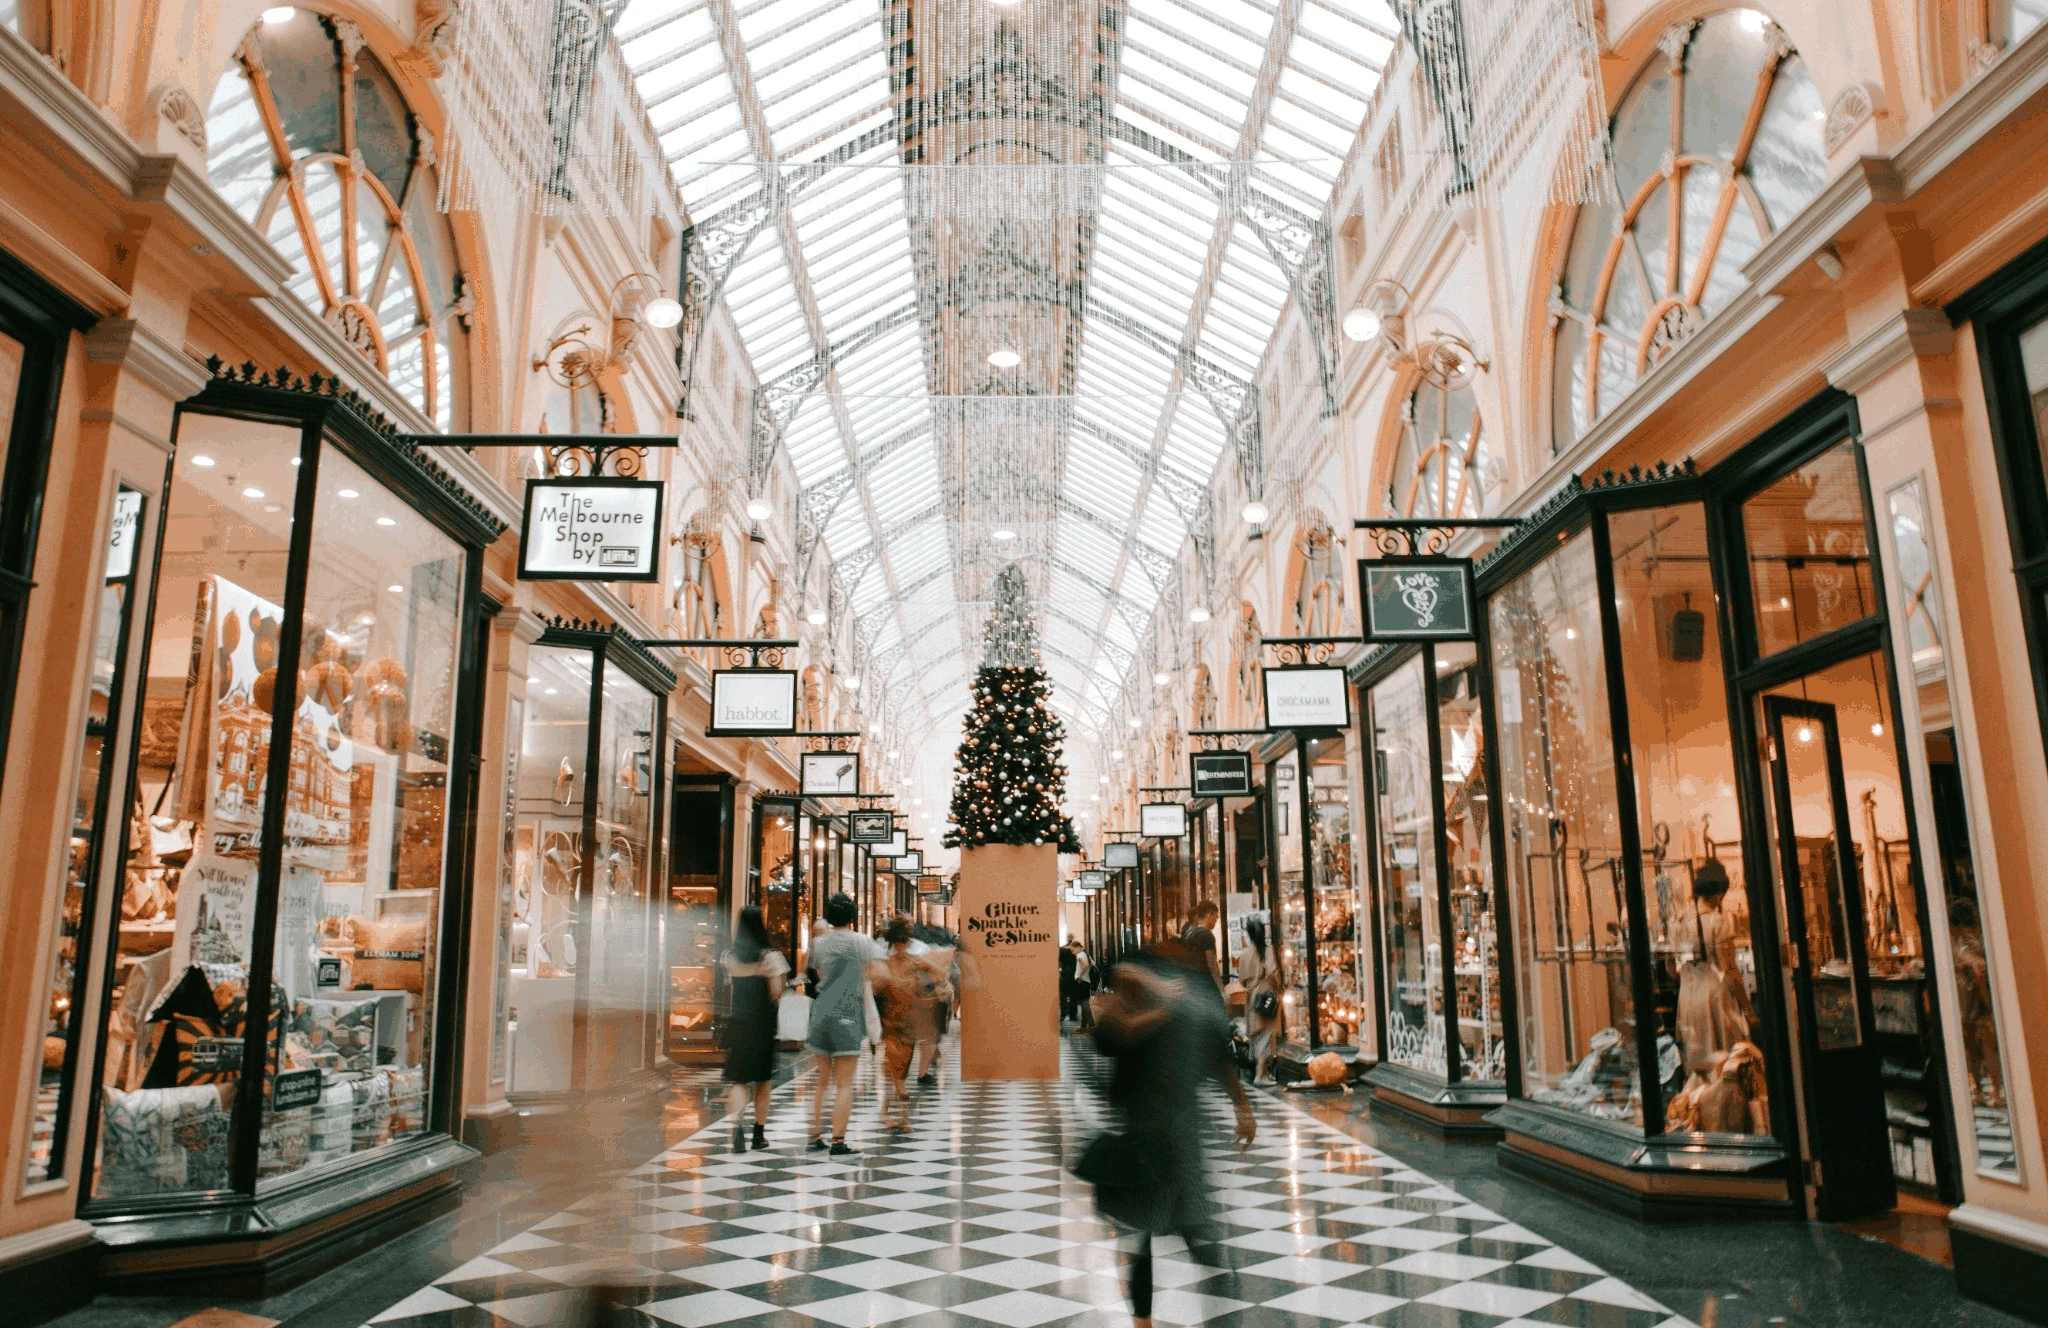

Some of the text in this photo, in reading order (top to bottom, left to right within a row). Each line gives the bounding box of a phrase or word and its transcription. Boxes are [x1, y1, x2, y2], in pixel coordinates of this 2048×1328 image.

[560, 492, 593, 508] The
[540, 507, 643, 524] Melbourne
[556, 525, 604, 546] Shop
[573, 541, 596, 563] by
[1277, 696, 1331, 707] CHOCAMAMA
[725, 706, 783, 721] habbot.
[985, 902, 1040, 918] Glitter.
[968, 916, 1028, 932] Sparkle
[1005, 930, 1051, 946] Shine
